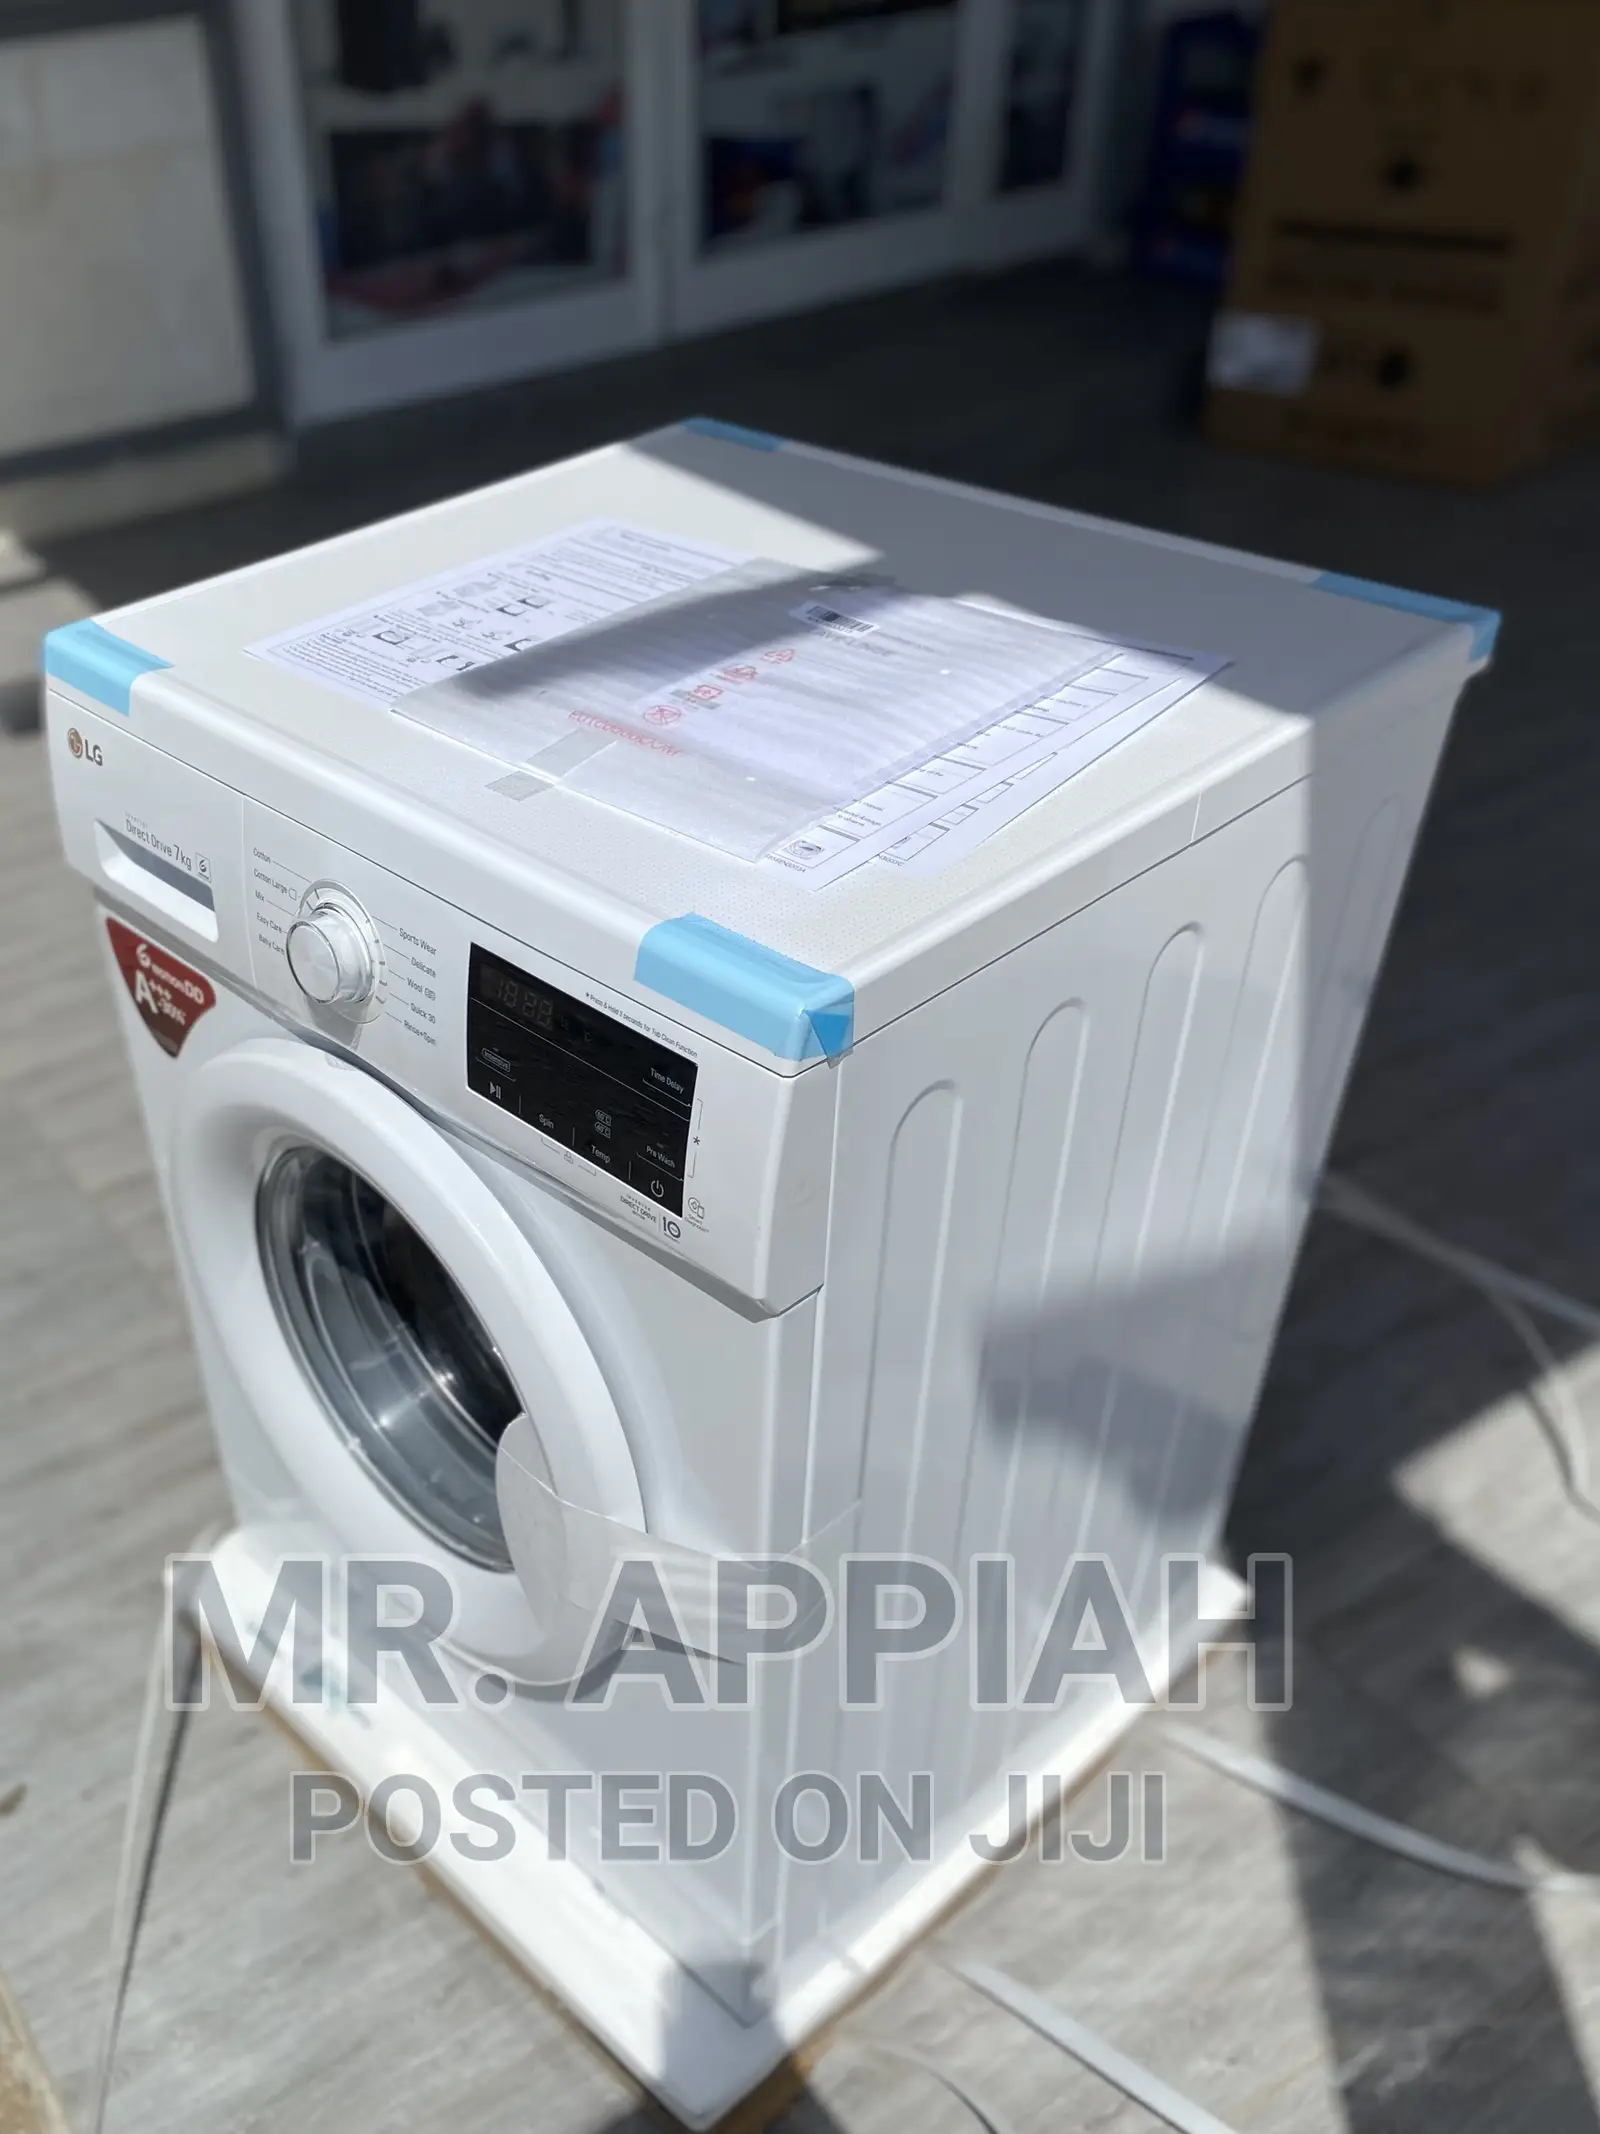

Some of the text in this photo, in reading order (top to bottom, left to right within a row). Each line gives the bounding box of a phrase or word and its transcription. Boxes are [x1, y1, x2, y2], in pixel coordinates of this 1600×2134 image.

[84, 738, 104, 767] LG
[125, 818, 150, 845] Direct
[151, 834, 172, 857] Drive
[253, 847, 271, 863] Cotton
[253, 868, 288, 894] Cotton Large
[255, 889, 265, 902] Mix
[256, 912, 282, 933] Easy Care
[258, 933, 285, 956] Baby Care
[399, 927, 437, 956] Sports Wear
[135, 943, 151, 969] 6
[411, 957, 436, 978] Delicate
[406, 976, 423, 994] Wool
[410, 1002, 436, 1024] Quick 30
[590, 994, 603, 1008] Press
[608, 1004, 619, 1015] Hold
[652, 1027, 661, 1038] Tub
[662, 1033, 675, 1045] Clean
[675, 1040, 698, 1058] Function
[650, 1067, 684, 1094] Time Delay
[539, 1113, 554, 1129] Spin
[591, 1144, 611, 1164] Temp
[646, 1145, 676, 1169] Pre Wash
[662, 1216, 681, 1239] 10
